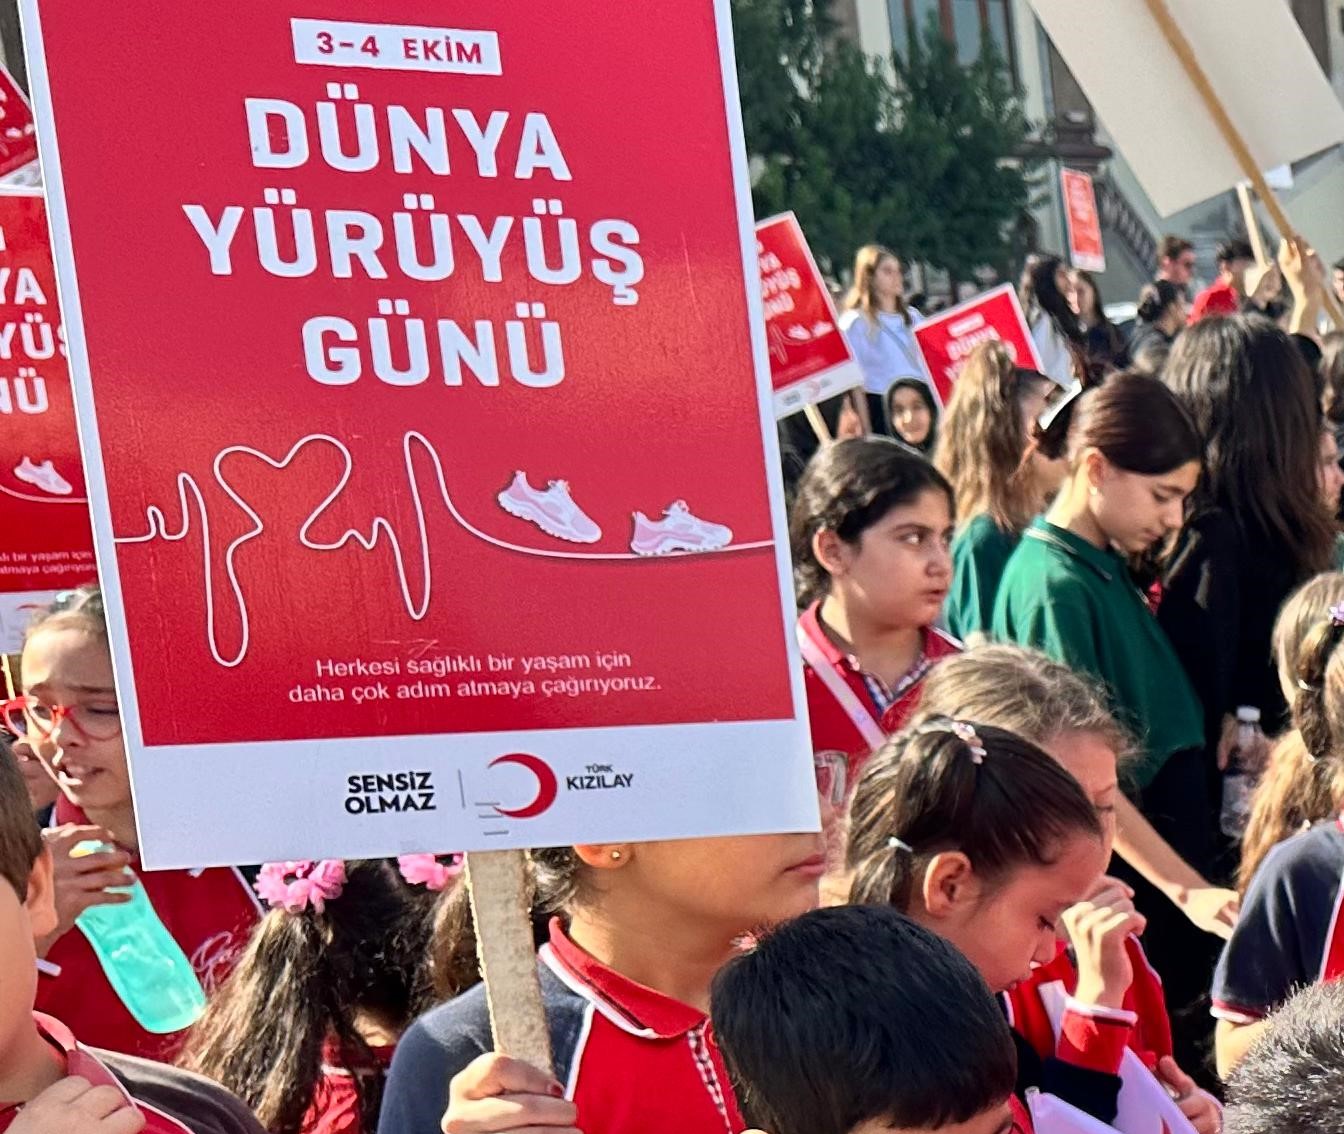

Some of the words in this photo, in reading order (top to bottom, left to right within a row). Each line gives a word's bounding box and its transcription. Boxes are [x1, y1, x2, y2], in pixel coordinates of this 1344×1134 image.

[317, 32, 380, 57] 3-4
[403, 36, 483, 64] EKİM
[245, 82, 572, 181] DÜNYA
[181, 187, 645, 306] YÜRÜYÜŞ
[302, 298, 566, 388] GÜNÜ
[316, 659, 400, 677] Herkesi
[407, 655, 482, 676] sağlıklı
[488, 656, 514, 672] bir
[521, 656, 591, 674] yaşam
[597, 652, 632, 670] için
[288, 684, 344, 703] daha
[351, 684, 389, 704] çok
[397, 680, 451, 699] adım
[542, 675, 662, 697] çağırıyoruz.
[585, 762, 613, 774] TÜRK
[348, 772, 433, 794] SENSİZ
[566, 774, 634, 791] KIZILAY
[345, 793, 436, 815] OLMAZ
